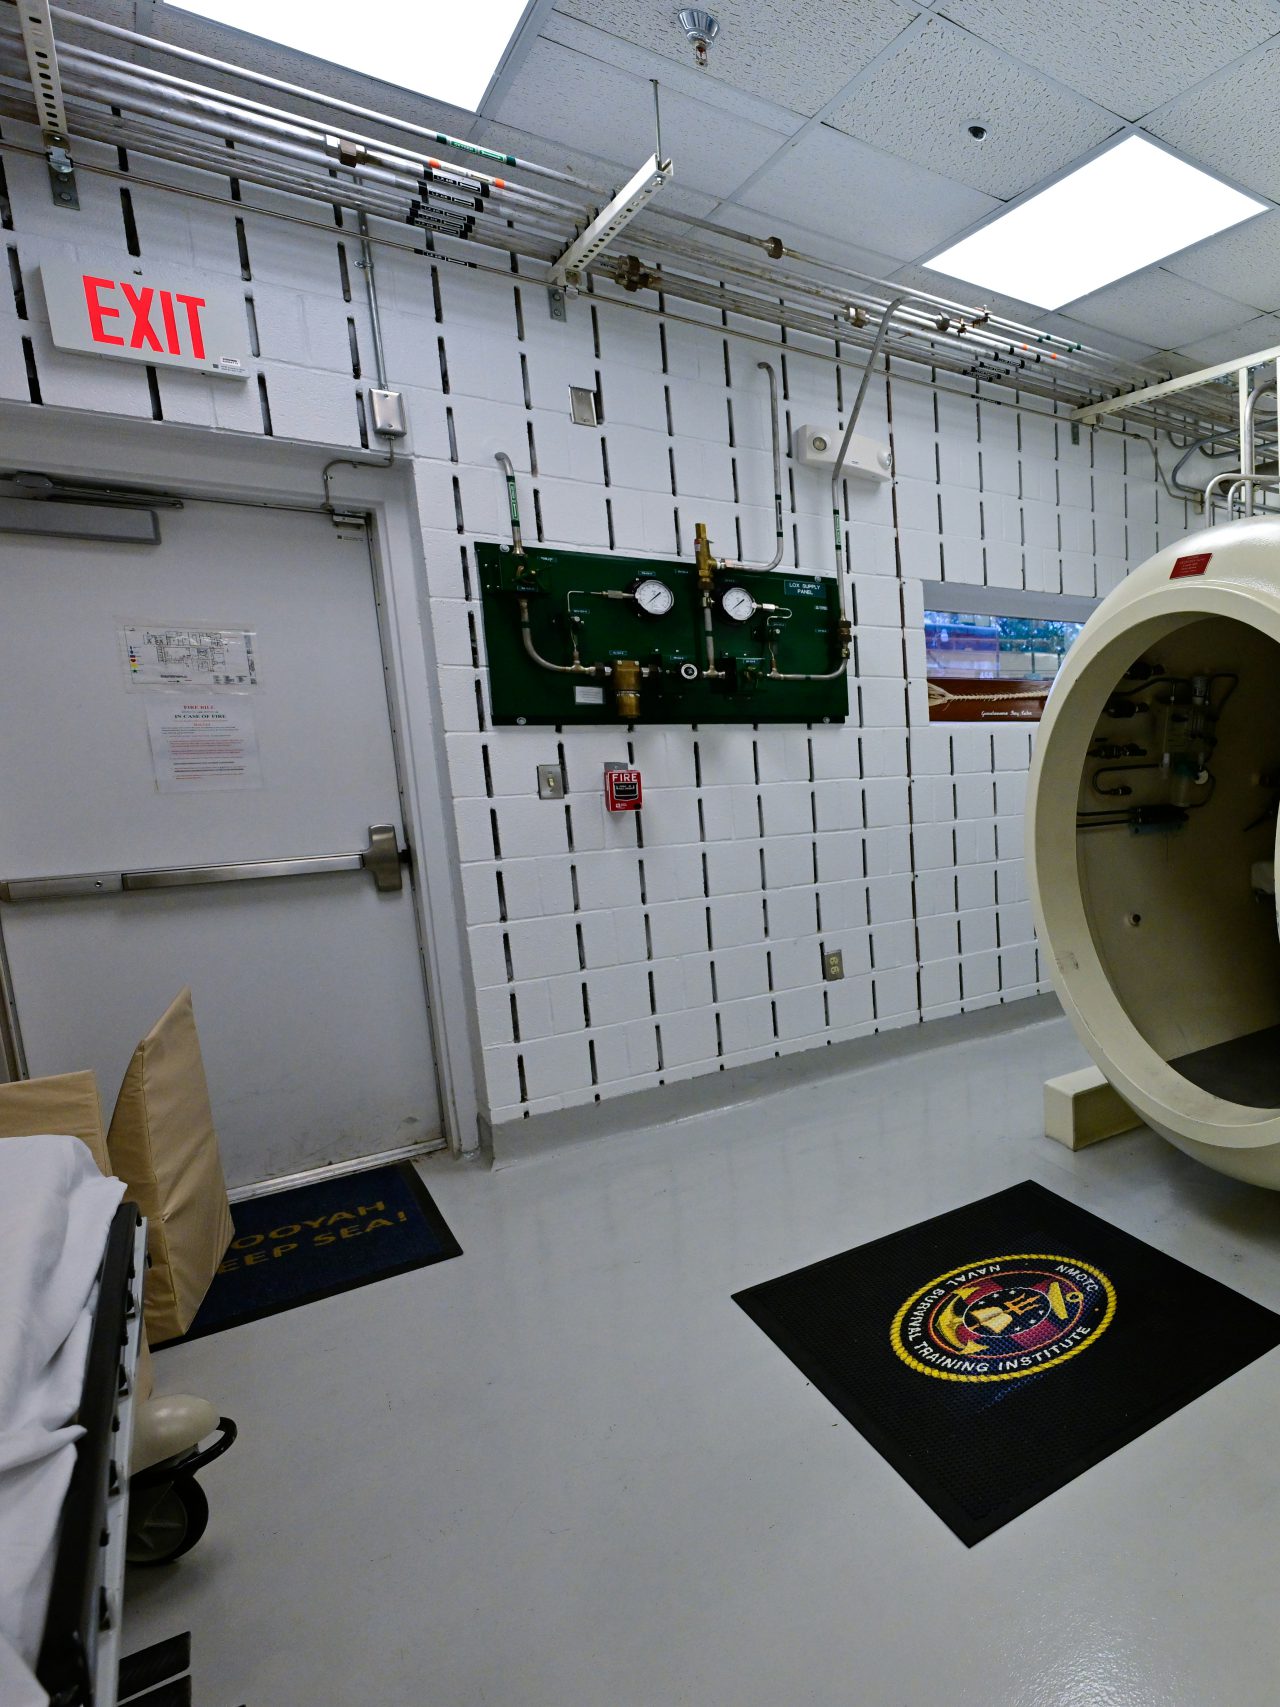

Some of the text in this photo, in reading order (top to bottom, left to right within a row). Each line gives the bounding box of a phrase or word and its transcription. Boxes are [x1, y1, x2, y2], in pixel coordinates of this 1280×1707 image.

[82, 275, 206, 360] EXIT
[612, 773, 638, 782] FIRE
[231, 1201, 385, 1249] OOYAH
[217, 1243, 298, 1274] EEP
[1056, 1264, 1099, 1292] NMOTC
[908, 1264, 1091, 1372] NAVAL SURVIVAL TRAINING INSTITUTE
